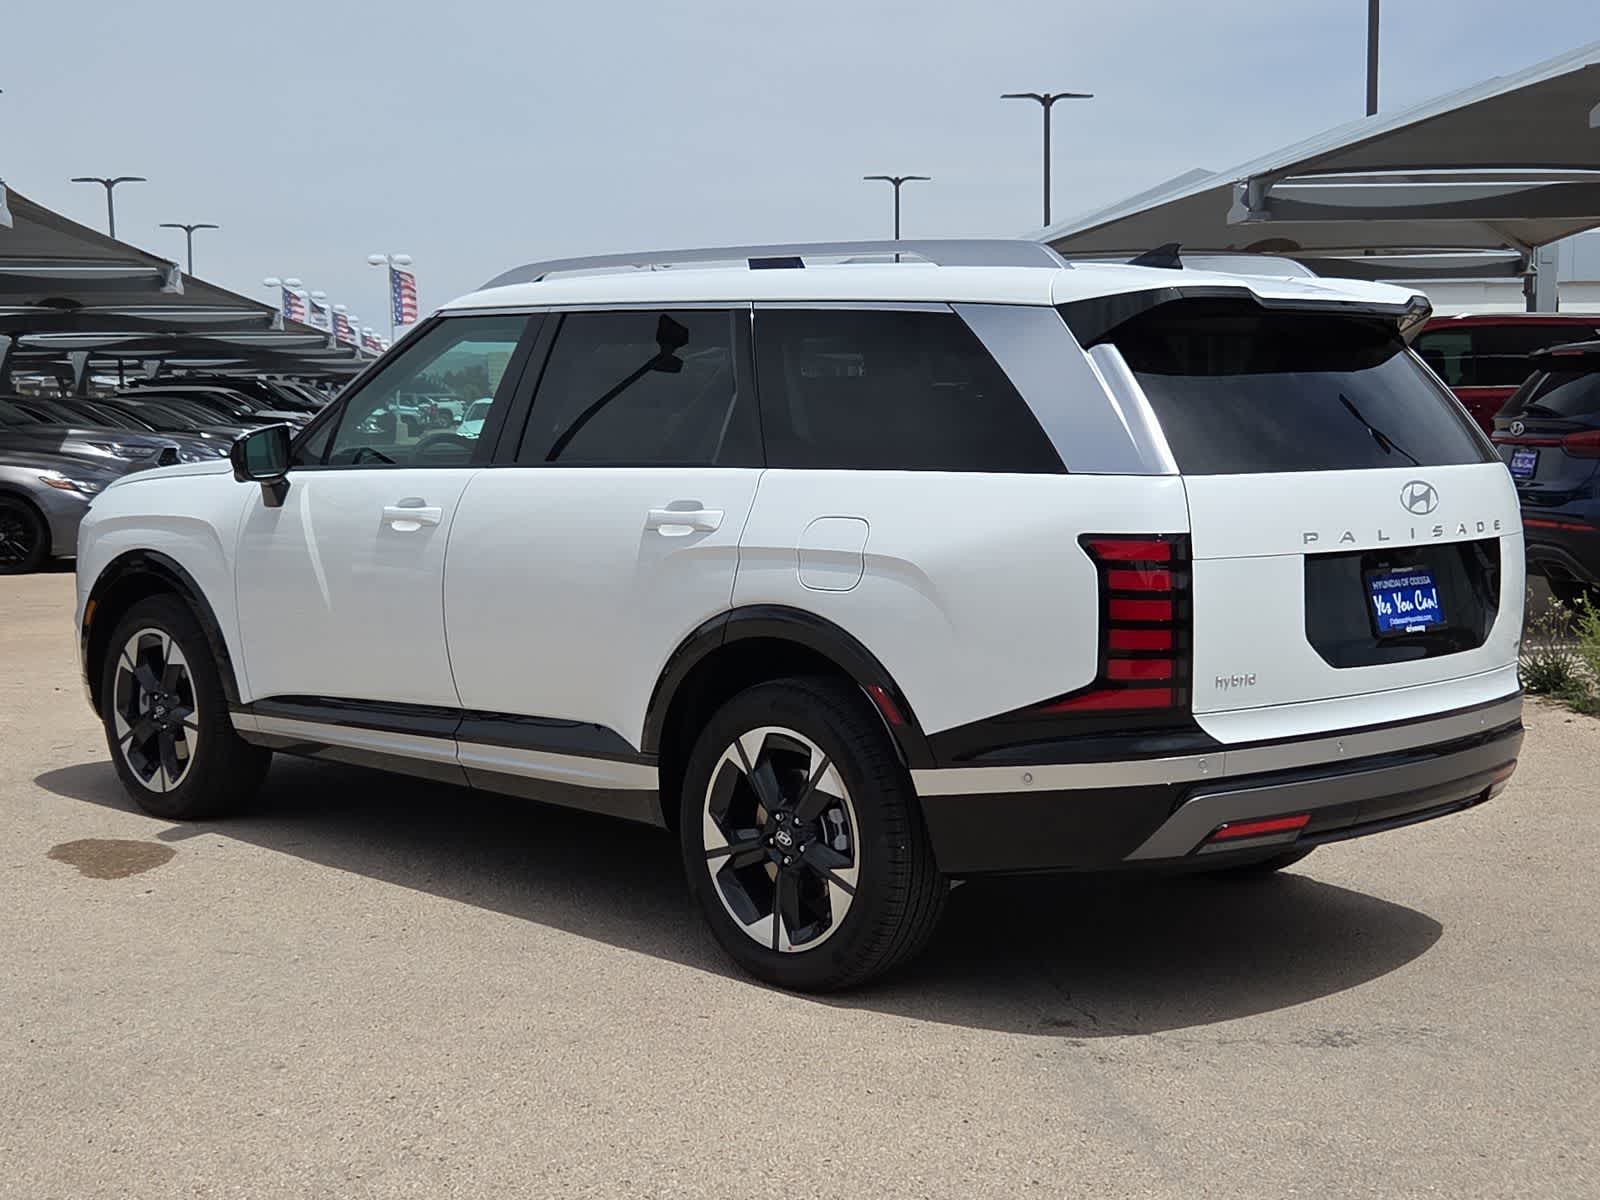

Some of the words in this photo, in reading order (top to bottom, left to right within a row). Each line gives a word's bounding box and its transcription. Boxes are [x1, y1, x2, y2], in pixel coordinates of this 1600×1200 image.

[1303, 520, 1501, 545] PALISADE
[1373, 594, 1392, 616] Yes
[1392, 591, 1414, 614] You
[1414, 587, 1438, 610] Can!
[1215, 673, 1257, 692] hybrid
